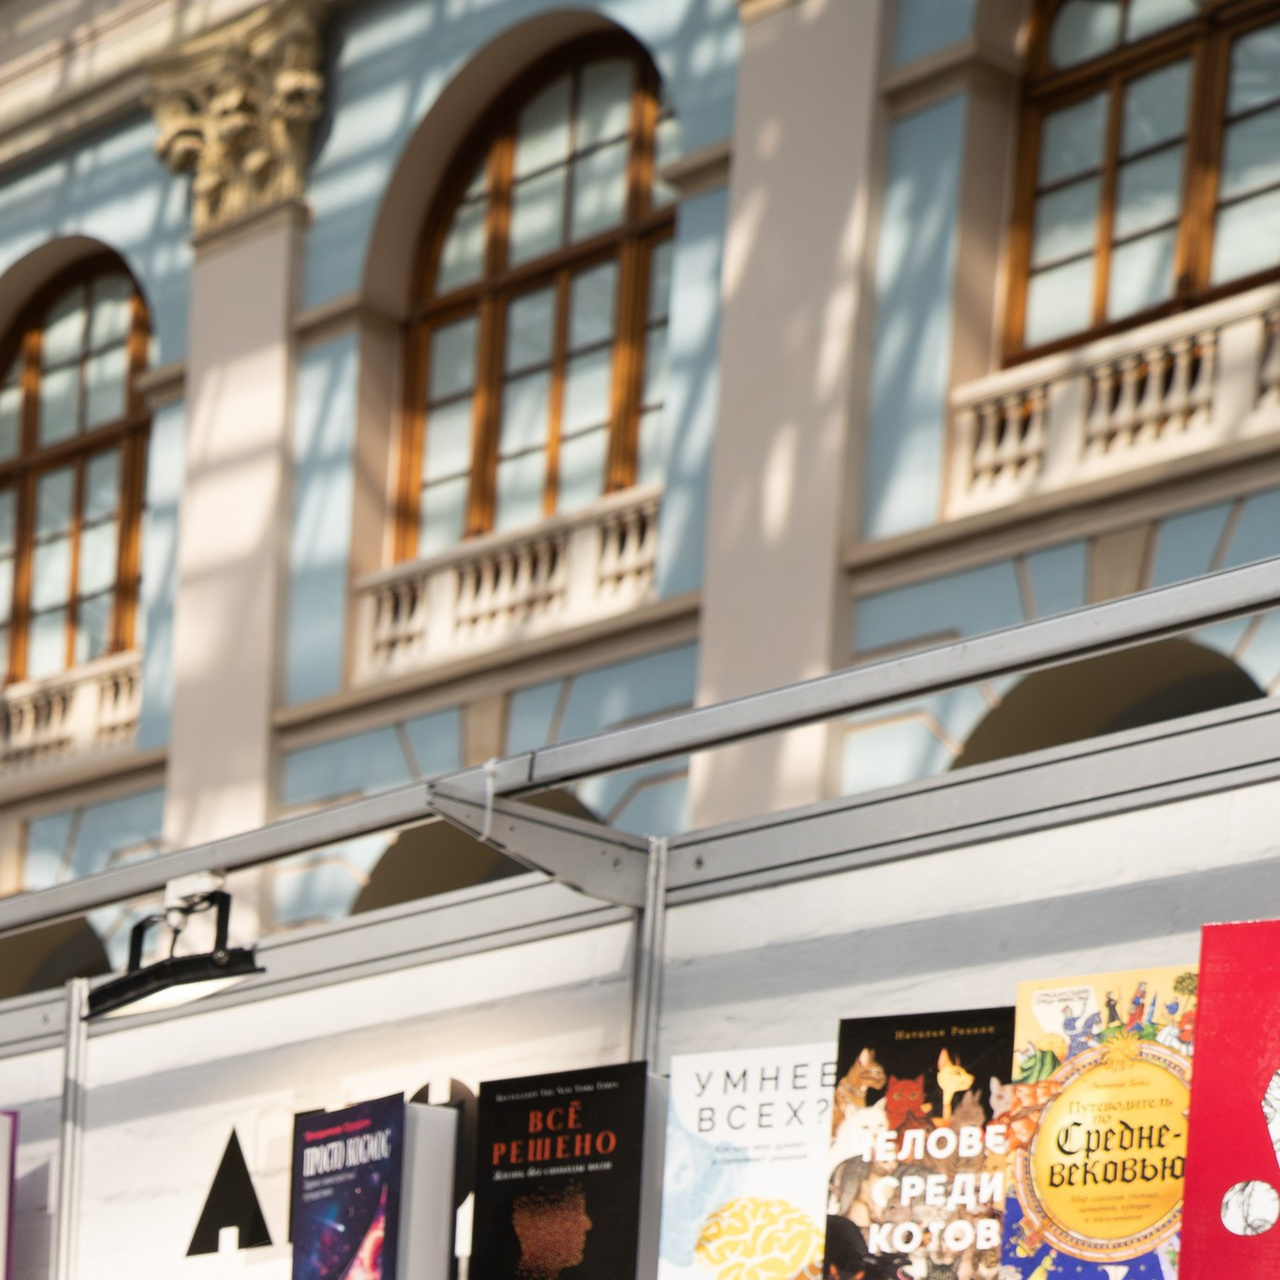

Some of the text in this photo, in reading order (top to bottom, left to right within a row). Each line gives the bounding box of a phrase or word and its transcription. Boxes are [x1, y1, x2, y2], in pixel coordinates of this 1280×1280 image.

[694, 1060, 838, 1098] УМНЕЕ
[528, 1100, 582, 1134] ВСЁ
[697, 1098, 830, 1133] ВСЕХ?
[491, 1130, 618, 1166] РЕШЕНО
[1057, 1120, 1182, 1158] Средне-
[1048, 1154, 1187, 1189] вековью
[872, 1172, 1006, 1211] СРЕДИ
[868, 1218, 1002, 1254] КОТОВ
